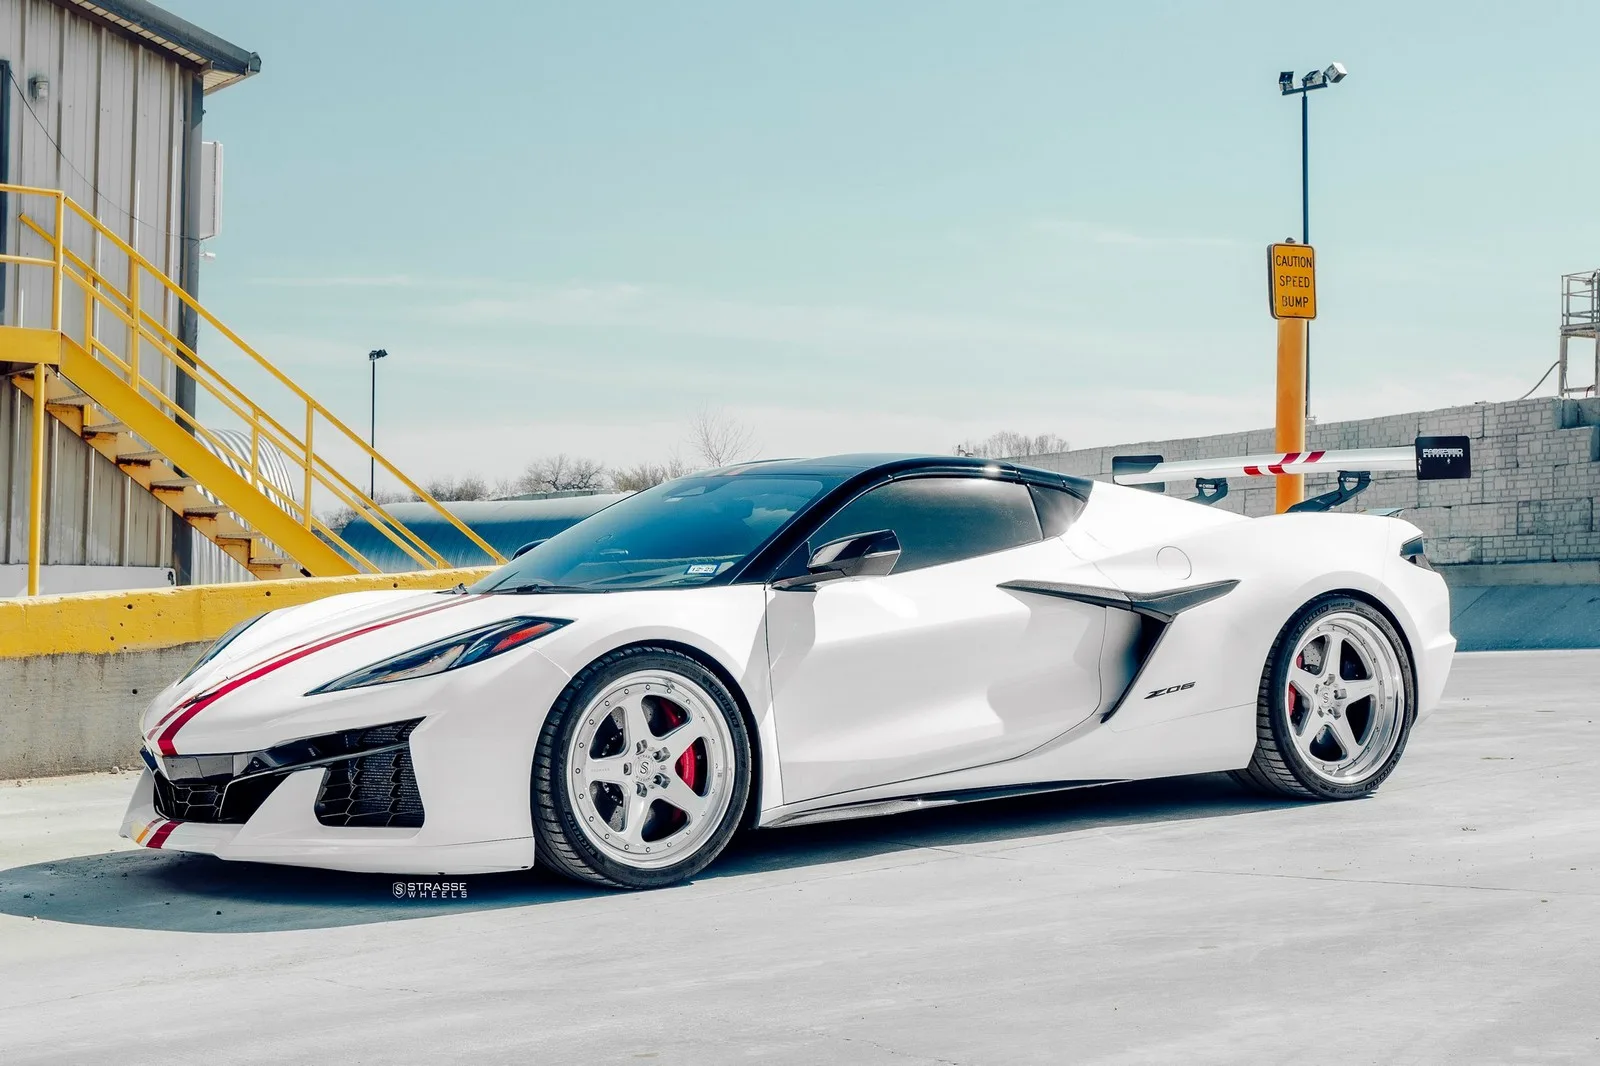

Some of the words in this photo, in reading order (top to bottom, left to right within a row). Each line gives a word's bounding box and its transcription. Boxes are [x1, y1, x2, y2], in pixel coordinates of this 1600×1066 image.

[1276, 255, 1312, 268] CAUTION
[1279, 275, 1310, 288] SPEED
[1281, 295, 1309, 308] BUMP
[1144, 681, 1196, 699] Z06
[710, 685, 739, 724] MICHELIN
[566, 814, 596, 855] MICHELIN
